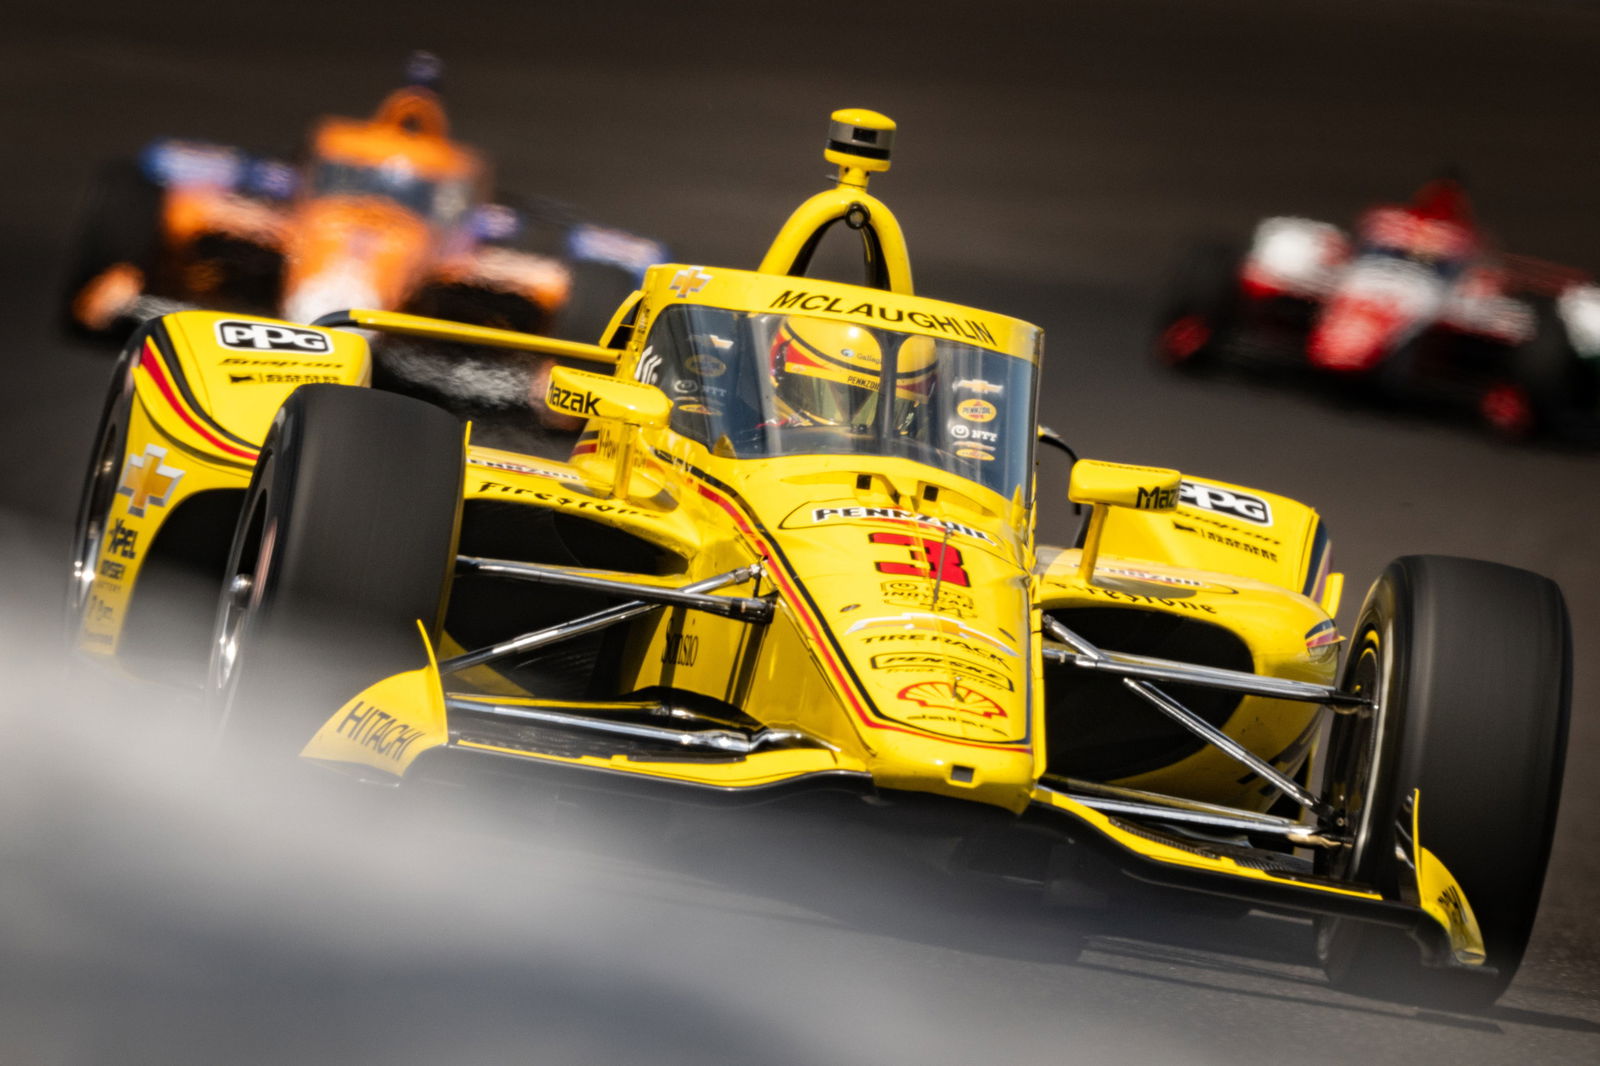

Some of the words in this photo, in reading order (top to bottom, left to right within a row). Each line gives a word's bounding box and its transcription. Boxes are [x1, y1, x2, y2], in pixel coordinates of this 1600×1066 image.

[221, 325, 327, 350] PPG
[769, 290, 998, 347] MCLAUGHLIN
[971, 429, 998, 442] NTT
[1135, 486, 1178, 510] Maz
[868, 531, 971, 588] 3
[336, 700, 426, 761] HITACHI
